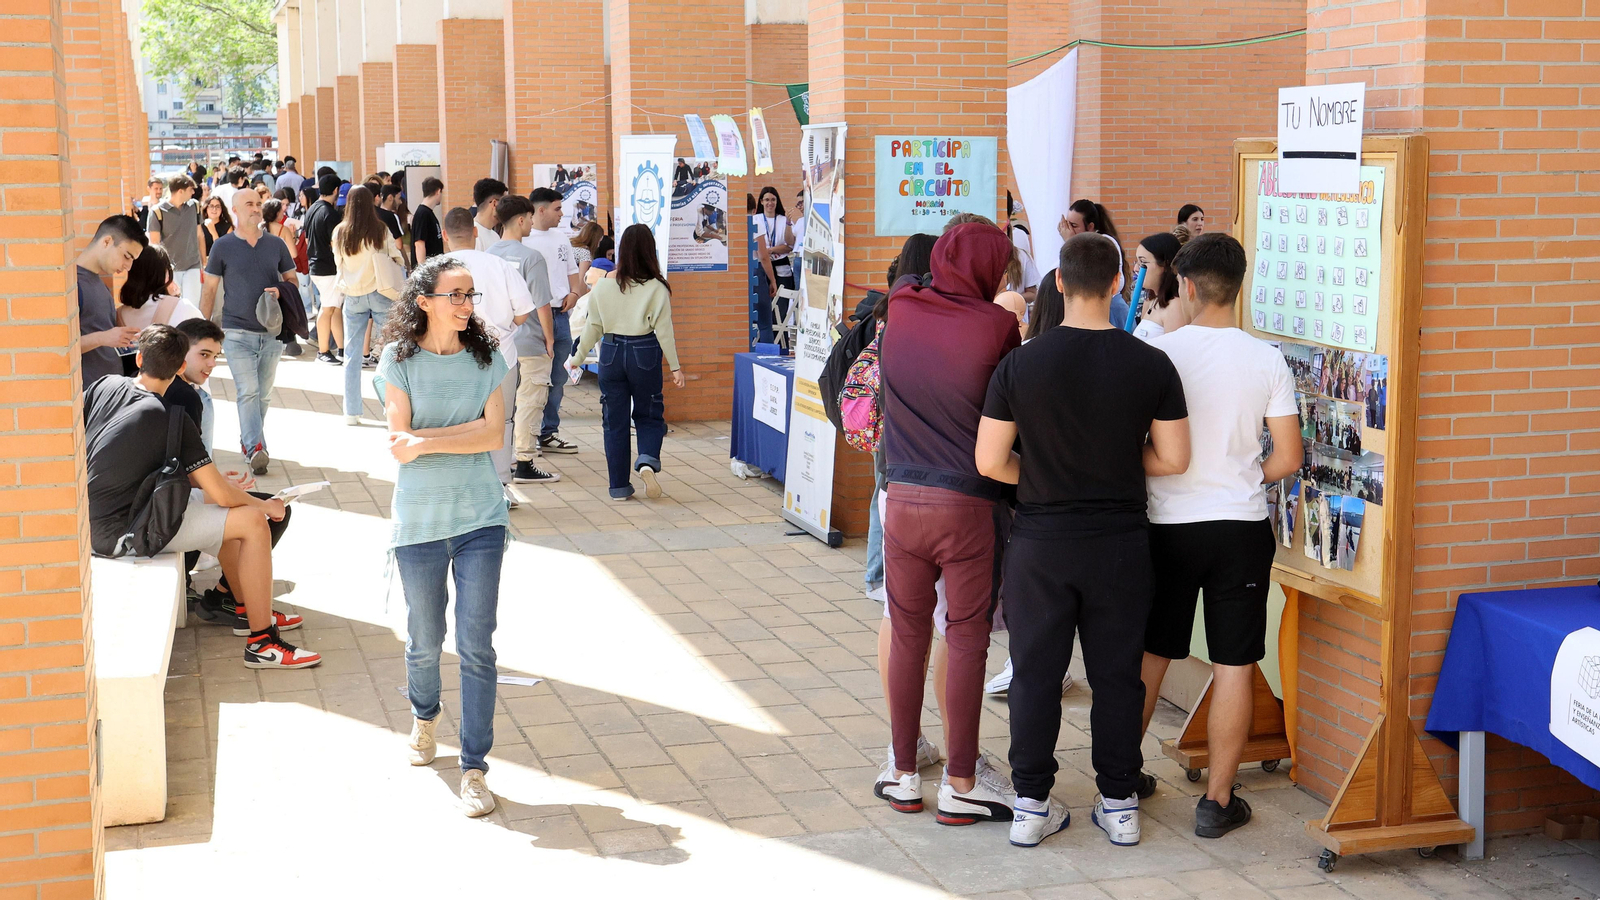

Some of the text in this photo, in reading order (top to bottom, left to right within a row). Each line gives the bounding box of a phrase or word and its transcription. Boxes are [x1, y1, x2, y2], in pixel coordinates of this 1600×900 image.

[1281, 96, 1358, 130] TU NOMBRE
[891, 137, 972, 158] PARTICIPA
[904, 161, 954, 175] EN EL
[899, 176, 970, 197] CIRCUITO
[1573, 699, 1598, 719] FERIA DE LA
